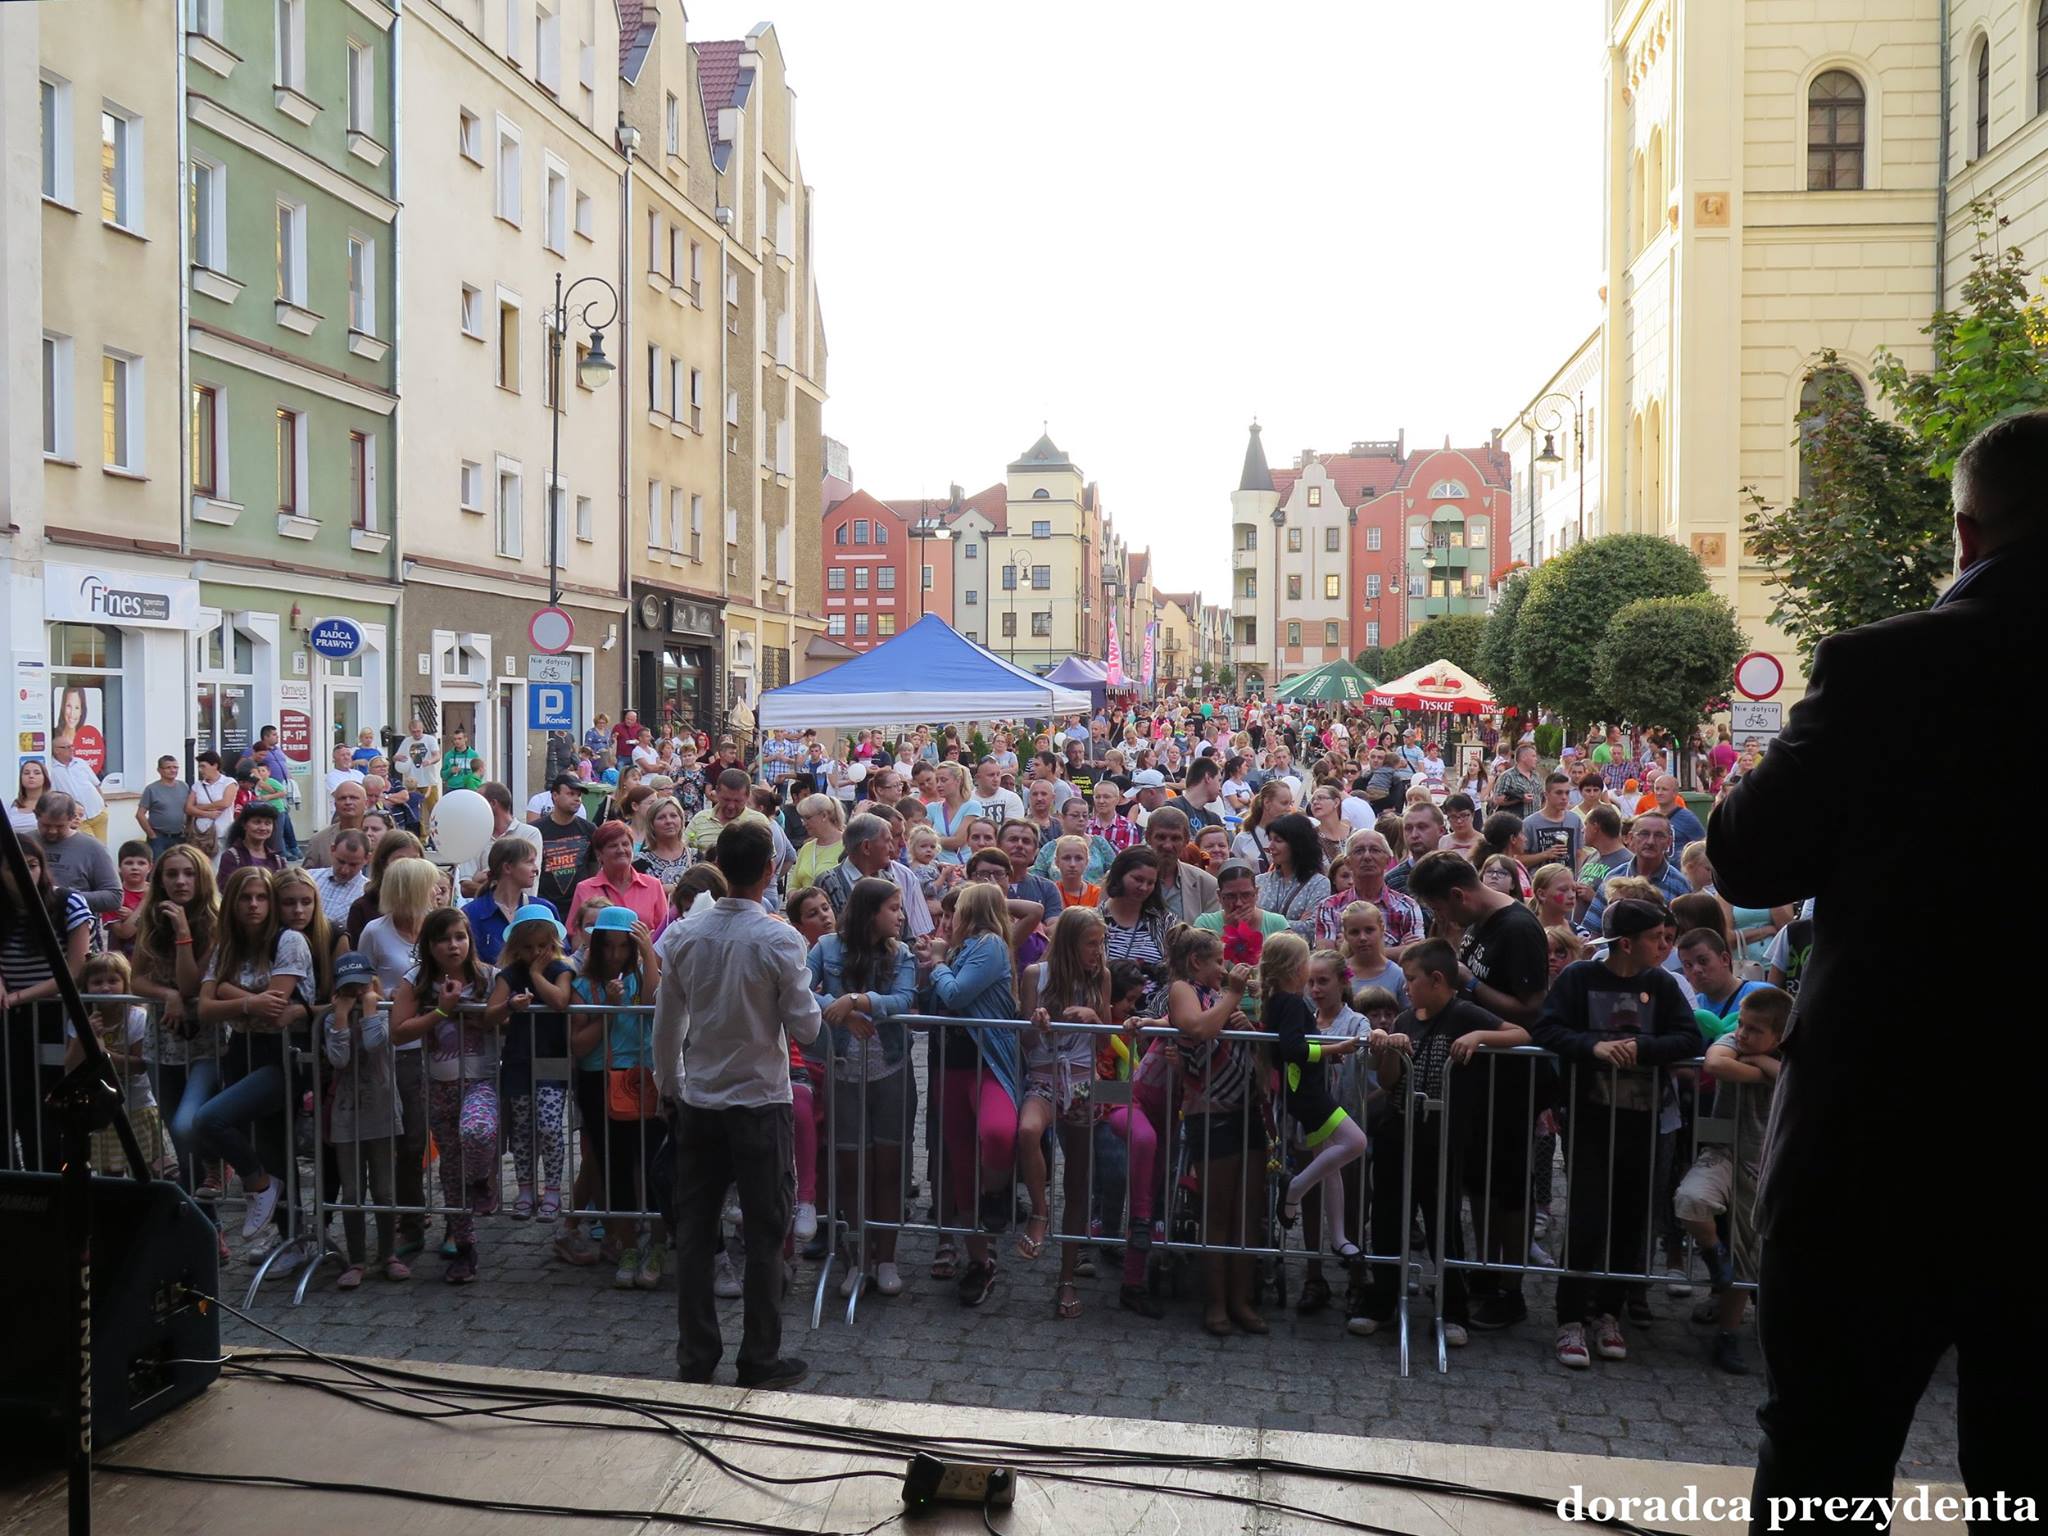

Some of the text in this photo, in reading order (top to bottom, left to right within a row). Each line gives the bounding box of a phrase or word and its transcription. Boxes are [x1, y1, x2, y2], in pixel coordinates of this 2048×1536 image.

[91, 585, 141, 616] Fines
[320, 629, 351, 640] RADCA
[316, 638, 354, 649] PRAWNY
[546, 658, 570, 667] dotyczy
[539, 689, 564, 724] P
[1372, 695, 1395, 707] TYSKIE
[1419, 699, 1455, 711] TYSKIE
[1751, 705, 1778, 714] dotyczy
[545, 715, 571, 724] Koniec
[338, 963, 364, 973] POLICJA
